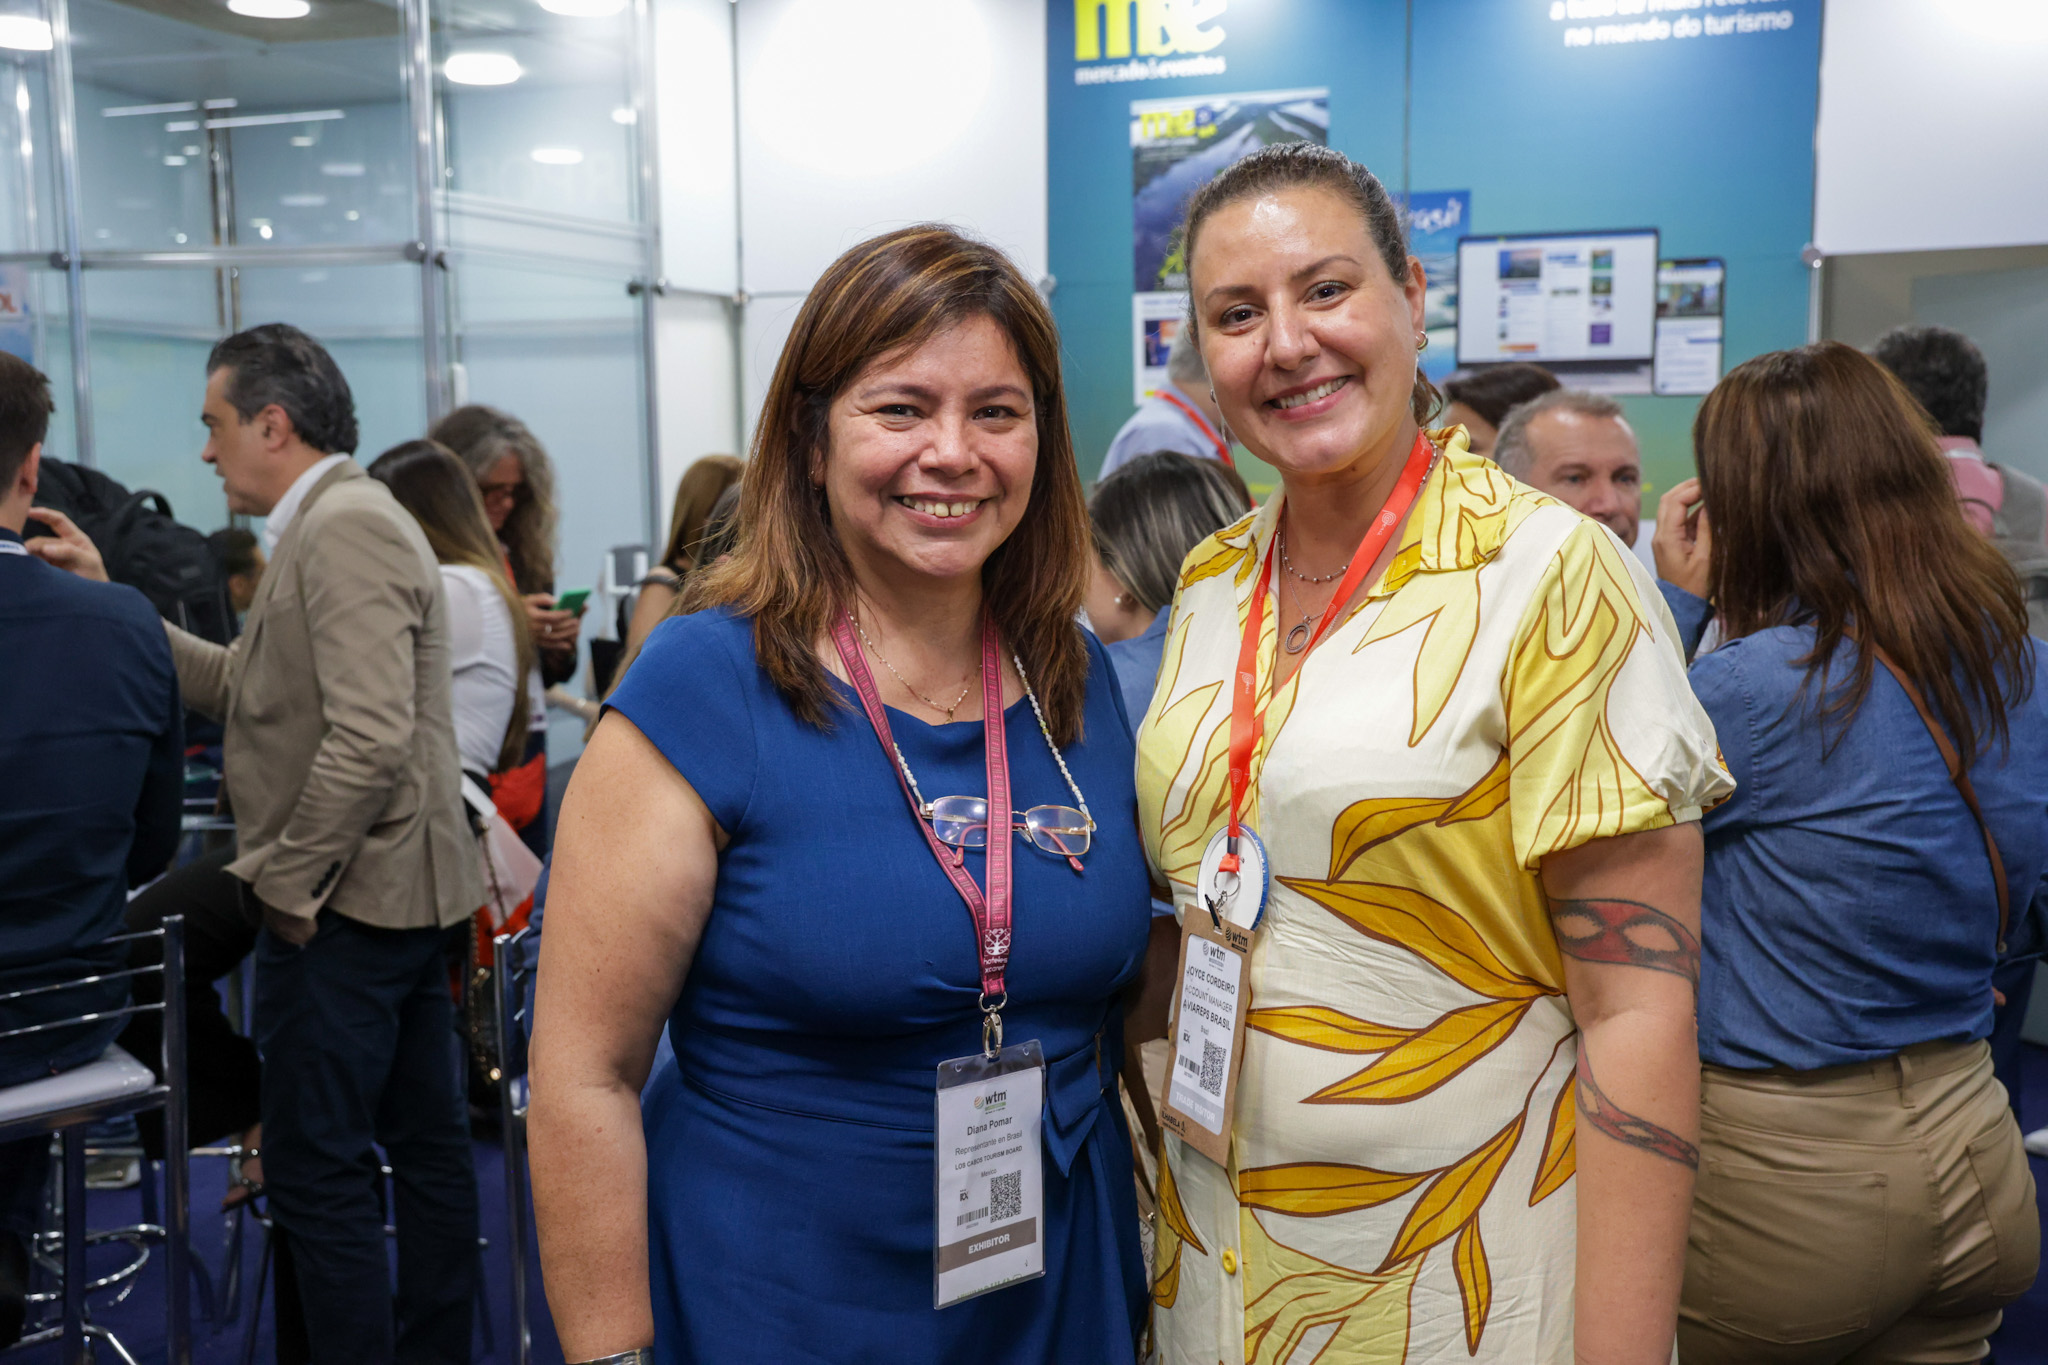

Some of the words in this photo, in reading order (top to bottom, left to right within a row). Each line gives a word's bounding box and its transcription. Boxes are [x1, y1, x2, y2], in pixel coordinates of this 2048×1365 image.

[1564, 26, 1593, 47] no
[1594, 16, 1671, 45] mundo
[1672, 14, 1702, 38] do
[1703, 9, 1794, 36] turismo
[1232, 931, 1248, 947] wtm
[1210, 945, 1226, 961] wtm
[1186, 965, 1205, 981] JOYCE
[1206, 973, 1235, 995] CORDEIRO
[1185, 984, 1209, 1000] ACCOUNT
[1208, 993, 1233, 1014] MANAGER
[1183, 999, 1210, 1020] AVIAREPS
[1210, 1012, 1231, 1031] BRASIL
[985, 1090, 1007, 1105] wtm
[967, 1123, 988, 1136] Diana
[989, 1116, 1012, 1129] Pomar
[955, 1138, 997, 1156] Representante
[998, 1136, 1006, 1144] en
[1006, 1130, 1022, 1142] Brasil
[955, 1162, 966, 1171] LOS
[966, 1156, 983, 1167] CABOS
[983, 1150, 1005, 1162] TOURISM
[1005, 1145, 1022, 1156] BOARD
[968, 1233, 1010, 1255] EXHIBITOR
